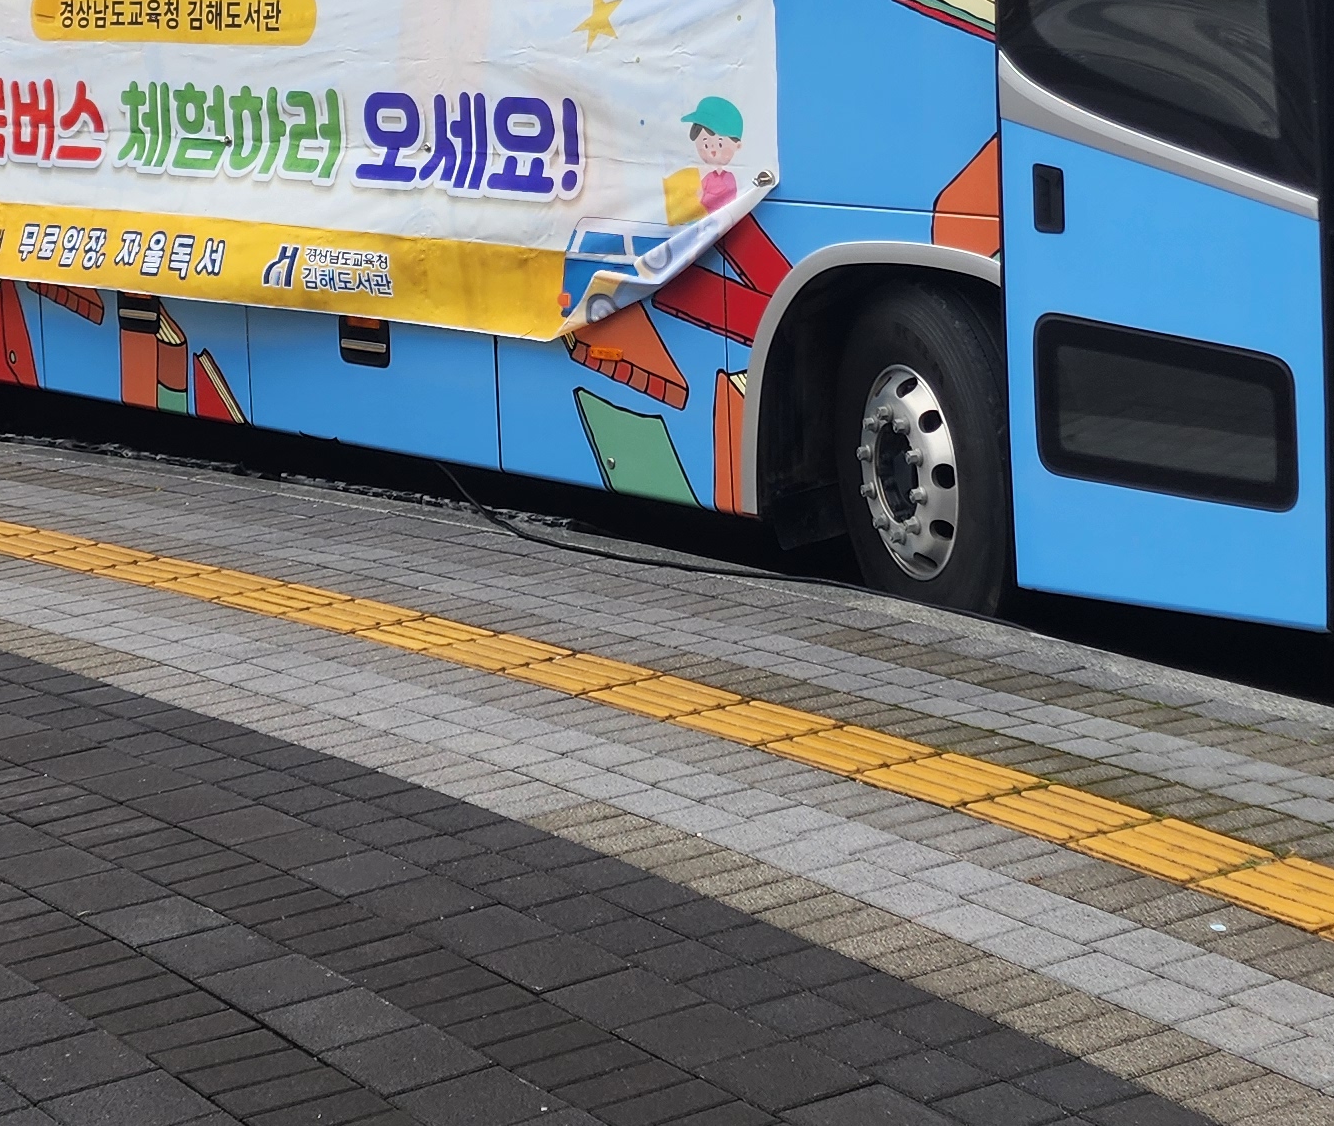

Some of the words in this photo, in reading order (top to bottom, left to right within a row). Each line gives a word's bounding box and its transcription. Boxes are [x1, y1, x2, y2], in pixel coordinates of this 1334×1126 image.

[186, 0, 282, 32] 김해도서관
[117, 80, 342, 179] 체험하러
[355, 91, 580, 193] 오세요!
[113, 230, 226, 280] 자율독서
[305, 247, 389, 271] 경상남도교육청
[301, 266, 393, 296] 김해도서관
